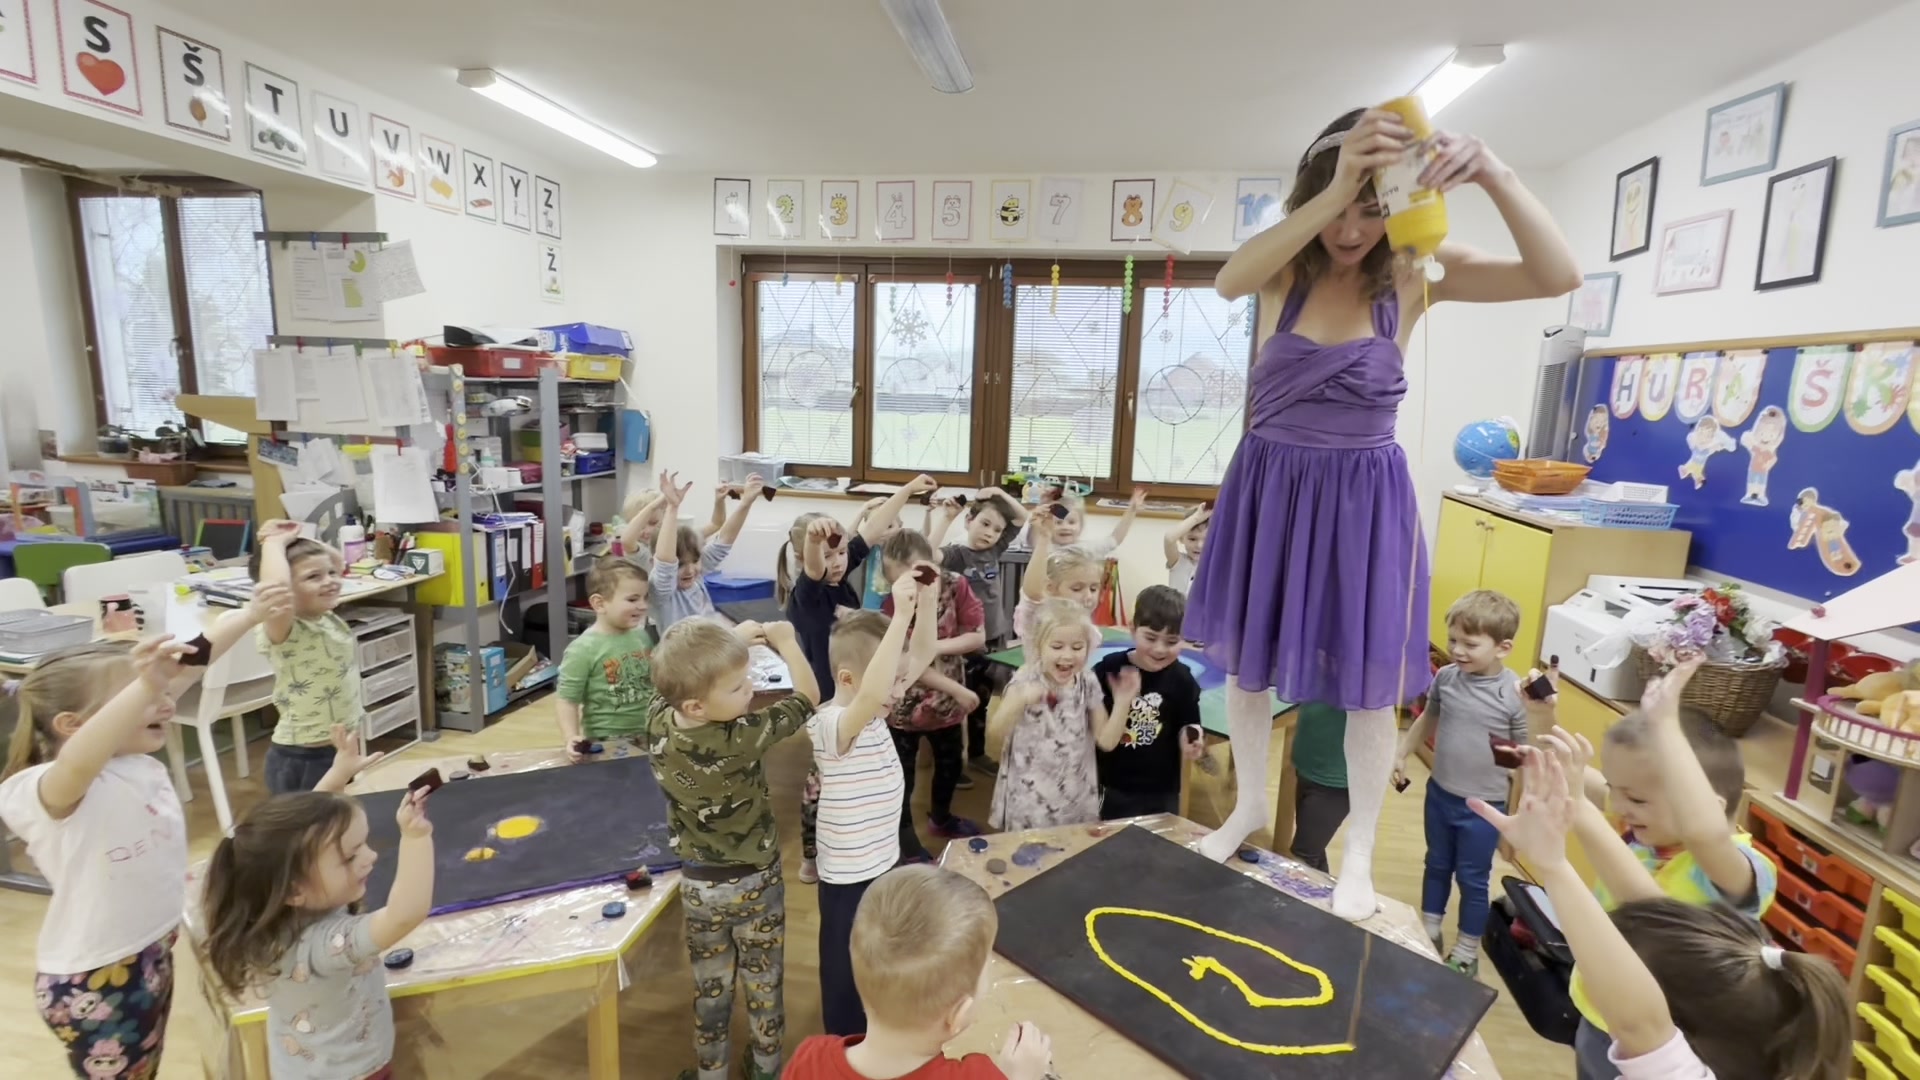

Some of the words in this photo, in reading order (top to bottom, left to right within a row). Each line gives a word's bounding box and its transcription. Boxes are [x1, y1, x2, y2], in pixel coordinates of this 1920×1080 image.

[83, 15, 111, 54] S
[182, 41, 205, 87] Š
[264, 83, 284, 115] T
[328, 107, 349, 138] U
[383, 129, 400, 154] V
[428, 146, 450, 175] W
[473, 162, 487, 188] X
[509, 175, 522, 198] Y
[543, 187, 554, 209] Z
[776, 194, 794, 224] 2
[830, 194, 848, 226] 3
[885, 196, 907, 229] 4
[942, 196, 961, 227] 5
[1000, 196, 1020, 227] 6
[1050, 196, 1071, 226] 7
[1121, 195, 1144, 227] 8
[1169, 201, 1194, 233] 9
[547, 246, 557, 272] Ž
